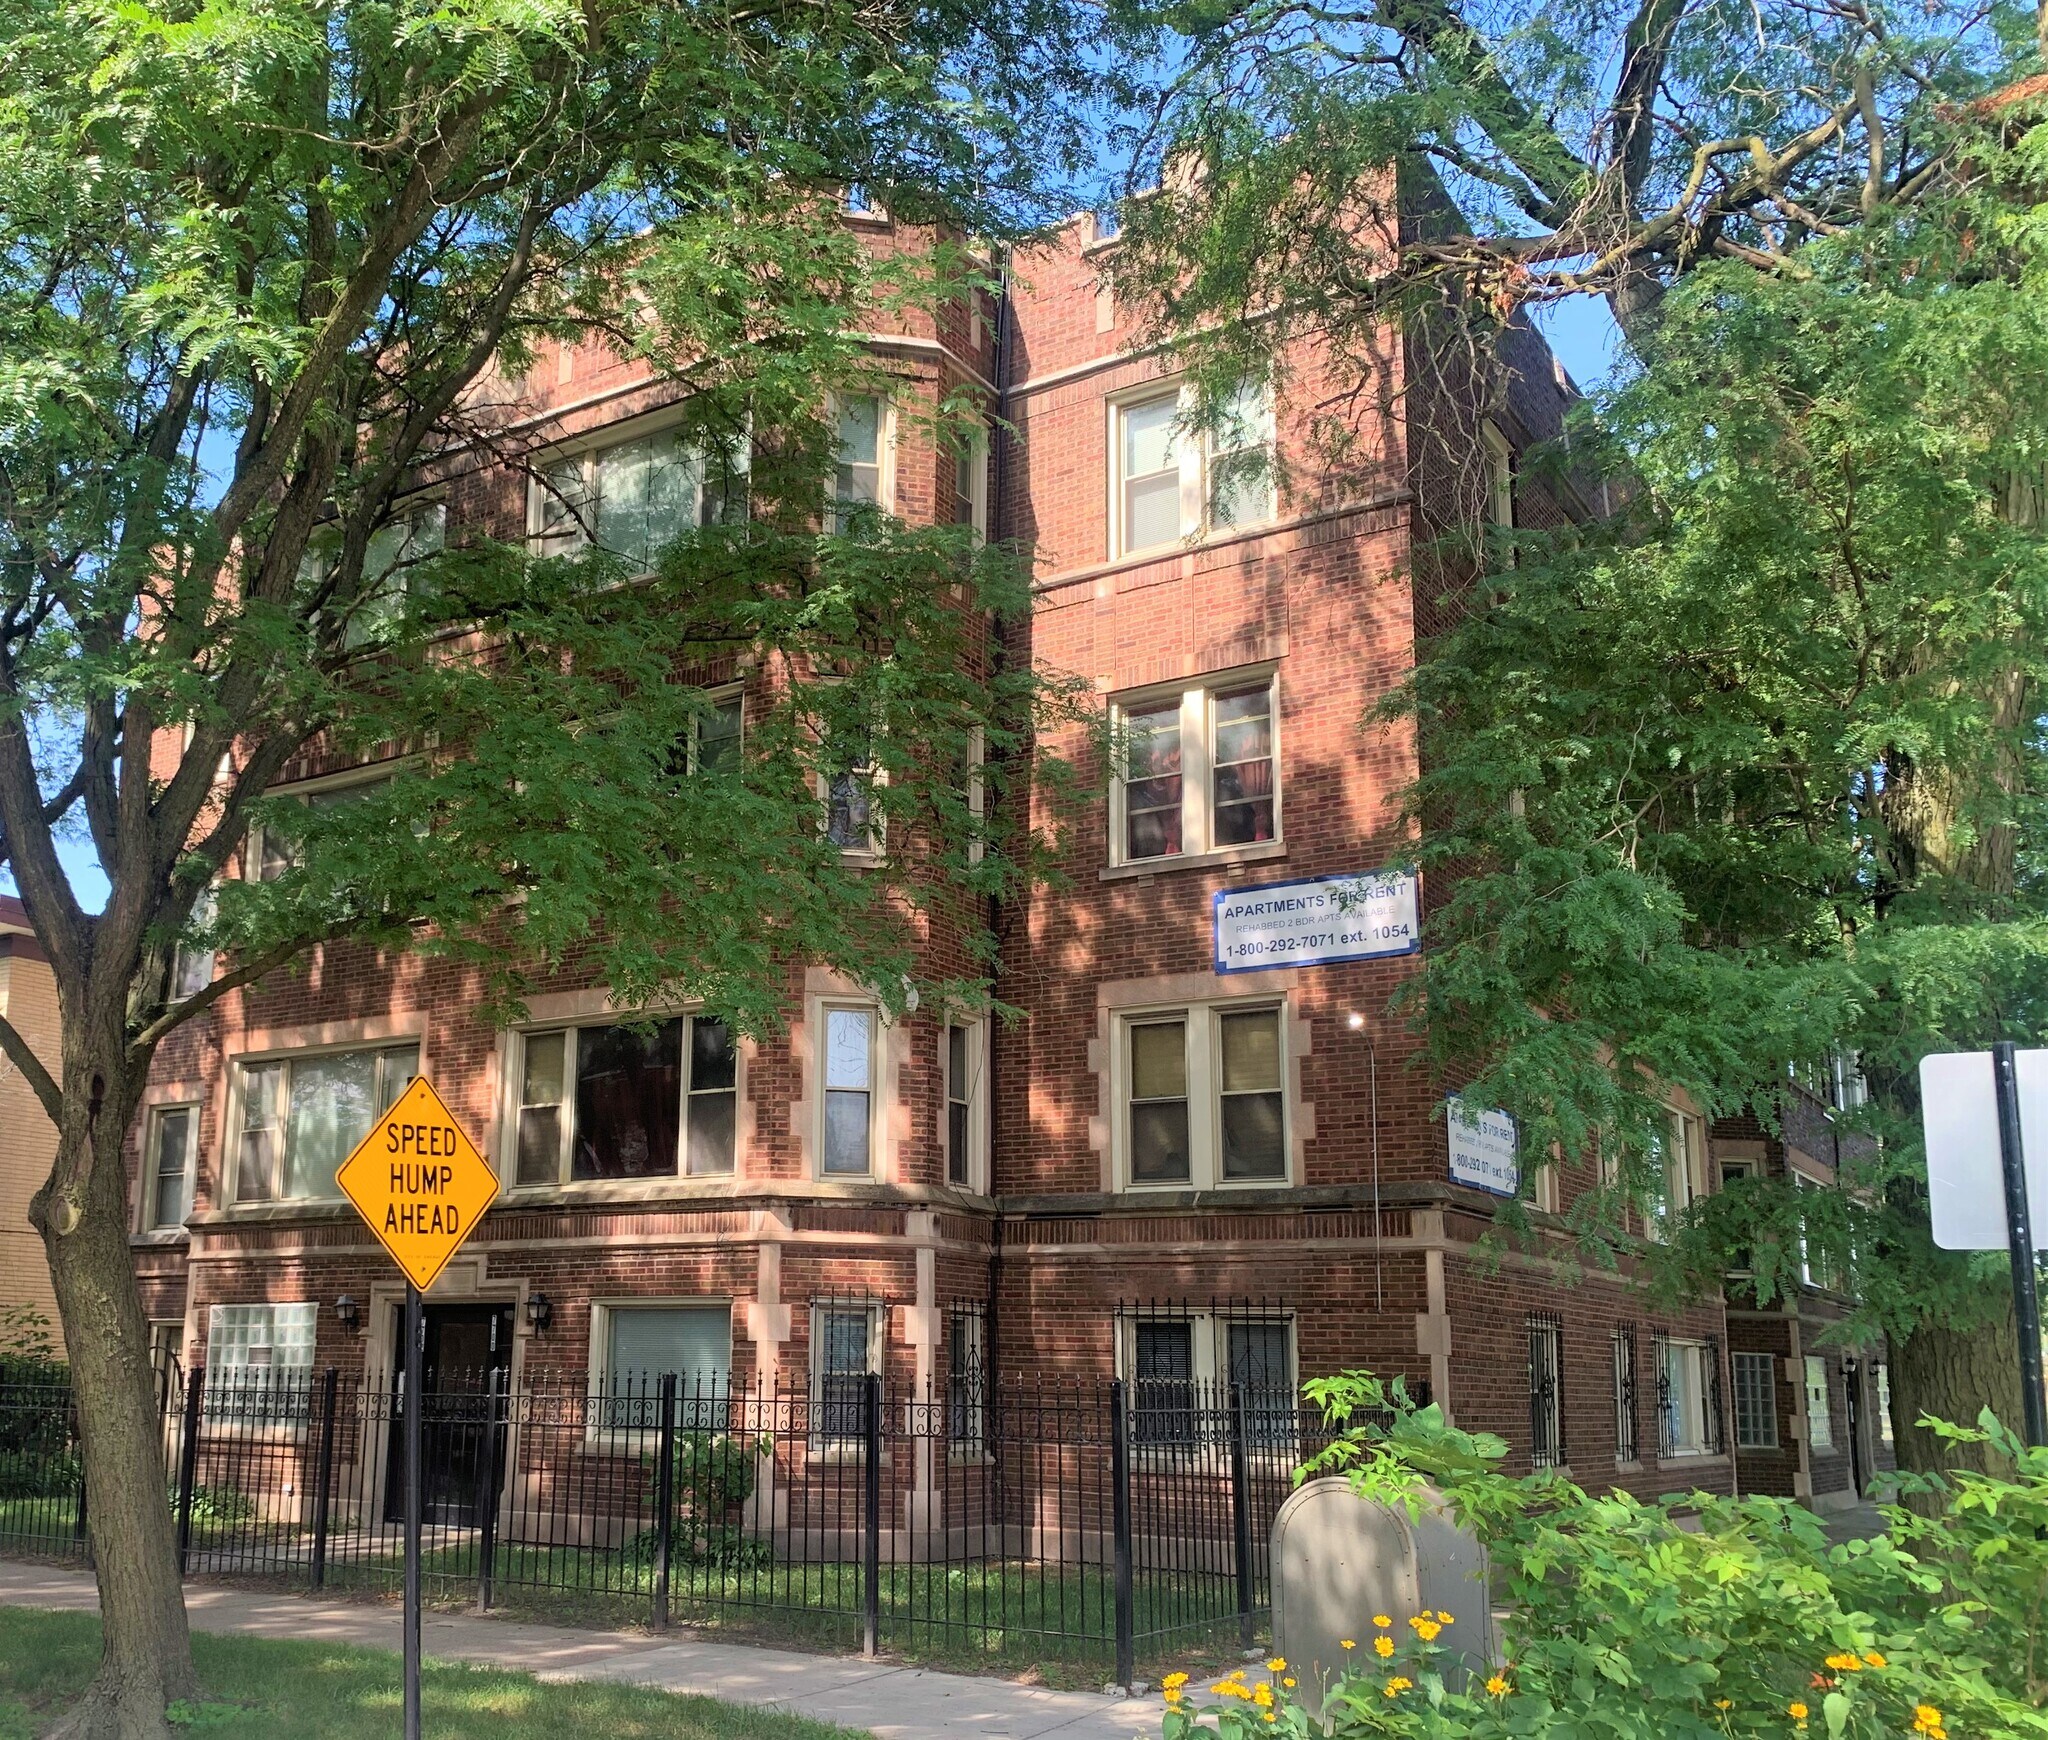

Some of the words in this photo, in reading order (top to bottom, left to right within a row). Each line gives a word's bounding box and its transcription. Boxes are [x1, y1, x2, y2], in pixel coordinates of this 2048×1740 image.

[1224, 895, 1325, 919] APARTMENTS
[1330, 890, 1358, 906] FOR
[1365, 882, 1406, 899] RENT
[1235, 920, 1285, 933] REHABBED
[1287, 918, 1294, 928] 2
[1295, 916, 1315, 927] BDR
[1317, 912, 1341, 924] APTS
[1343, 905, 1397, 921] AVAILABLE
[1226, 933, 1334, 957] 1-800-292-7071
[1340, 930, 1368, 946] ext.
[1373, 923, 1410, 941] 1054
[386, 1123, 457, 1157] SPEED
[390, 1163, 453, 1195] HUMP
[384, 1203, 459, 1235] AHEAD
